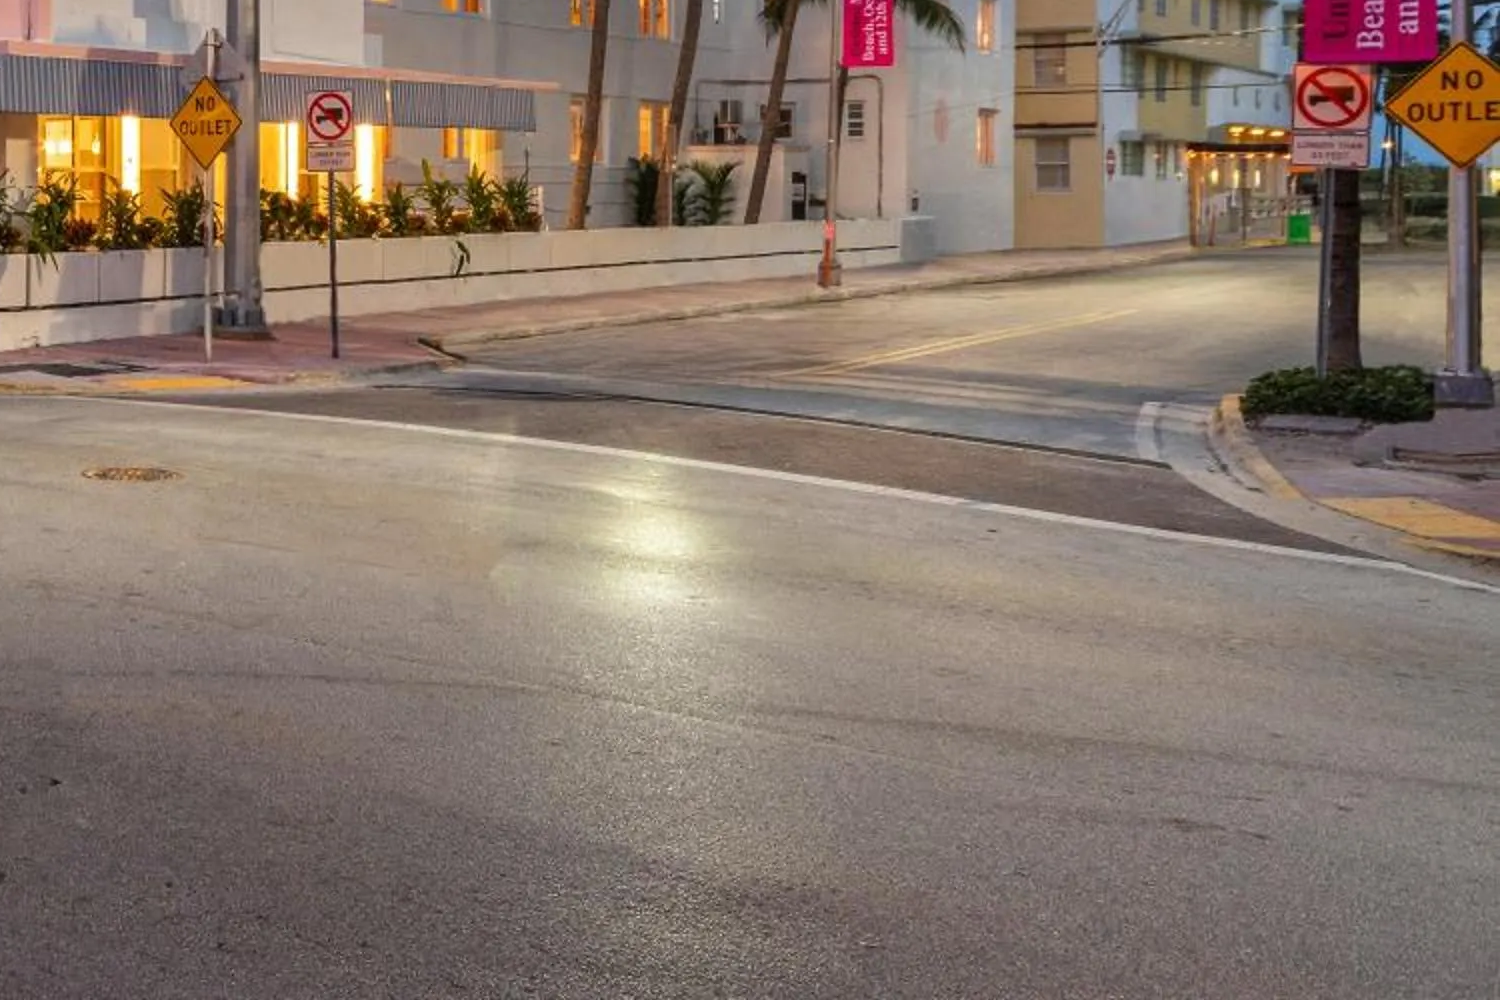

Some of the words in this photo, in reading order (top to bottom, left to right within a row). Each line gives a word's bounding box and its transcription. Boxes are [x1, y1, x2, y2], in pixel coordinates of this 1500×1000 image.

[1441, 69, 1484, 91] NO
[195, 98, 215, 113] NO
[1407, 100, 1500, 124] OUTLE
[179, 118, 232, 136] OUTLET
